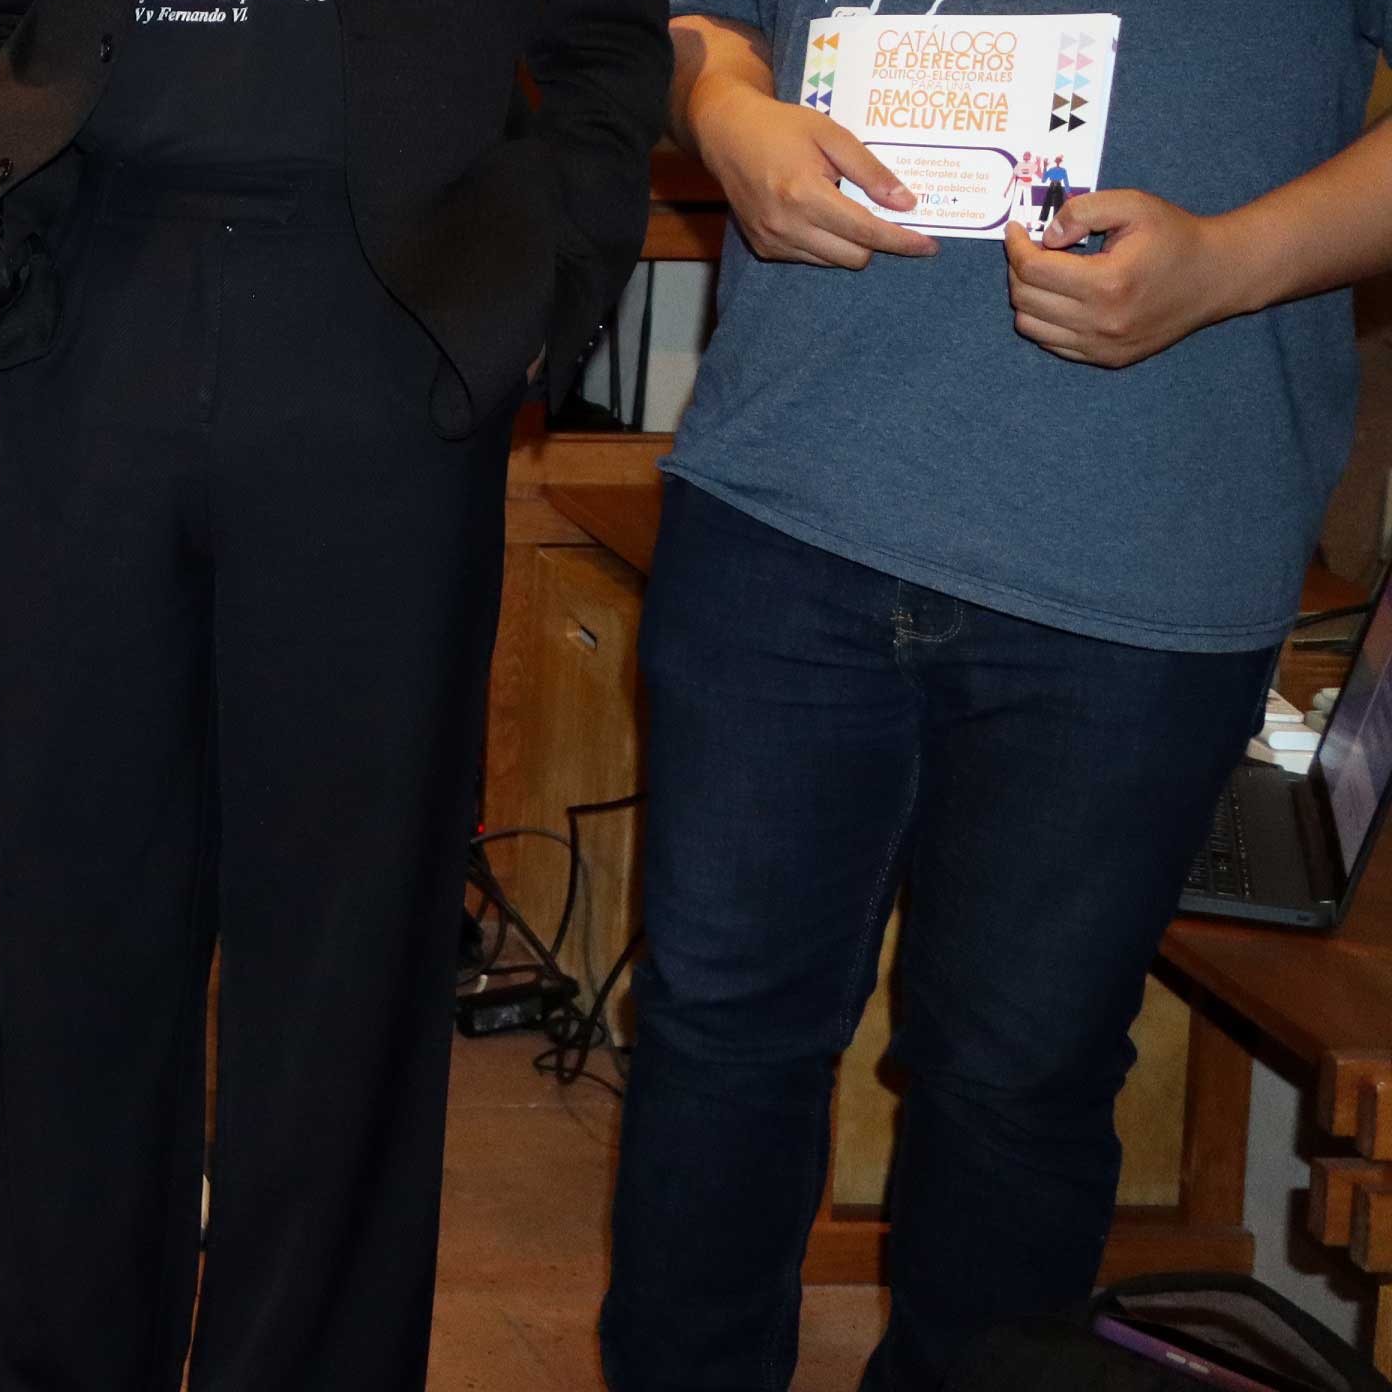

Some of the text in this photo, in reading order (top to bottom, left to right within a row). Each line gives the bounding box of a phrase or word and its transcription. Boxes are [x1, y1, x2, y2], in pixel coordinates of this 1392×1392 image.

[157, 6, 227, 23] Fernando
[876, 24, 1018, 56] CATÁLOGO
[873, 51, 1016, 71] DE DERECHOS
[911, 79, 943, 90] PARA
[868, 88, 1009, 110] DEMOCRACIA
[865, 106, 1009, 133] INCLUYENTE
[895, 156, 961, 169] Los derechos
[960, 169, 974, 180] de
